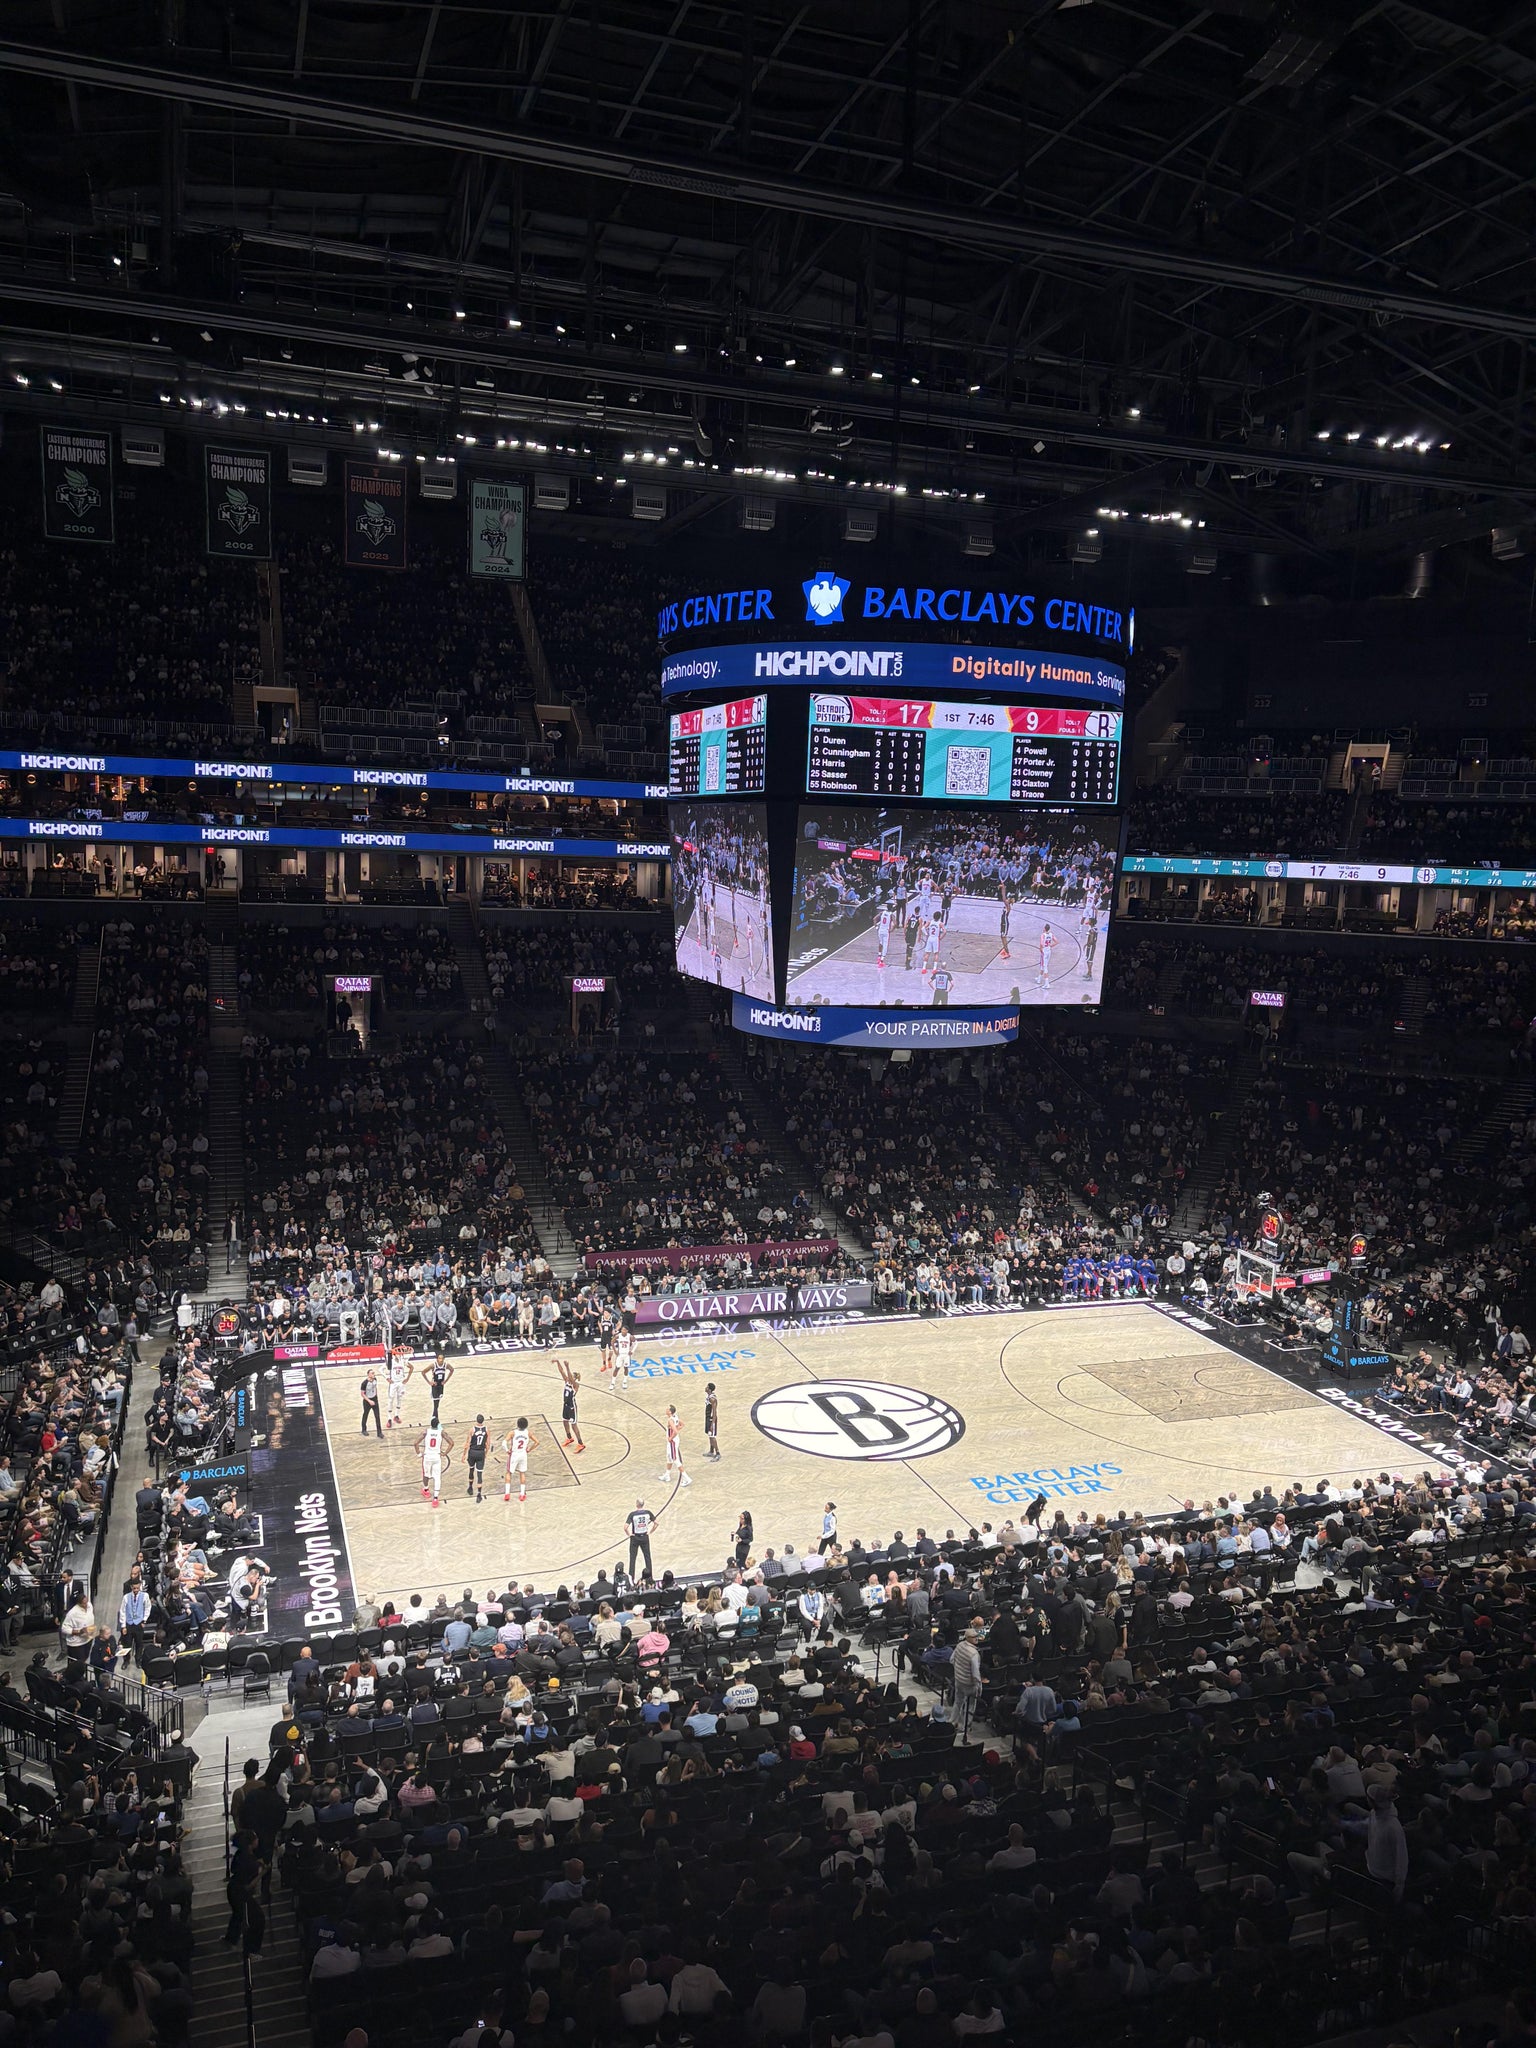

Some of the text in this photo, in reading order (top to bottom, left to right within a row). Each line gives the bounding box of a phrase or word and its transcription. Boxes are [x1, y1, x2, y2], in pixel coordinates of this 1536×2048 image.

[48, 445, 107, 466] CHAMPIONS
[210, 464, 266, 484] CHAMPIONS
[350, 478, 402, 497] CHAMPIONS
[488, 486, 509, 499] WNBA
[475, 496, 522, 513] CHAMPIONS
[64, 524, 96, 535] 2000
[224, 540, 255, 551] 2002
[361, 551, 390, 561] 2023
[485, 565, 510, 574] 2024
[682, 589, 775, 629] CENTER
[862, 587, 1122, 643] BARCLAYS CENTER
[667, 660, 721, 681] Technology.
[755, 651, 894, 677] HIGHPOINT
[952, 656, 1036, 683] Digitally
[1041, 663, 1095, 685] Human.
[730, 706, 737, 725] 9
[817, 705, 845, 714] DETROIT
[899, 704, 925, 725] 17
[816, 714, 845, 723] PISTONS
[945, 713, 995, 726] 1ST 7:46
[1026, 712, 1039, 732] 9
[814, 735, 820, 743] 0
[823, 736, 847, 746] Duren
[876, 739, 882, 747] 5
[890, 740, 895, 748] 1
[813, 747, 819, 755] 2
[822, 747, 871, 759] Cunningham
[890, 751, 894, 759] 1
[1023, 747, 1048, 756] Powell
[1073, 749, 1079, 757] 0
[1085, 749, 1091, 757] 0
[1110, 750, 1115, 758] 0
[21, 755, 101, 771] HIGHPOINT
[811, 759, 821, 767] 12
[821, 759, 846, 768] Harris
[875, 762, 881, 770] 2
[888, 762, 894, 770] 0
[903, 763, 908, 771] 1
[1023, 758, 1046, 767] Porter
[1046, 759, 1056, 767] Jr.
[1084, 760, 1090, 768] 0
[1109, 761, 1115, 769] 0
[194, 763, 267, 778] HIGHPOINT
[810, 770, 820, 778] 25
[821, 771, 848, 779] Sasser
[888, 773, 893, 781] 0
[902, 774, 907, 782] 1
[1022, 769, 1054, 779] Clowney
[1071, 770, 1077, 778] 0
[1085, 771, 1089, 779] 1
[353, 771, 423, 785] HIGHPOINT
[1012, 779, 1022, 787] 33
[1022, 780, 1050, 788] Claxton
[1071, 781, 1077, 789] 0
[505, 779, 571, 793] HIGHPOINT
[810, 781, 820, 789] 55
[821, 782, 858, 791] Robinson
[888, 784, 893, 792] 1
[901, 785, 907, 793] 2
[915, 785, 920, 793] 1
[1022, 790, 1045, 799] Traore
[1096, 792, 1100, 800] 1
[29, 823, 99, 836] HIGHPOINT
[202, 828, 266, 842] HIGHPOINT
[341, 834, 403, 846] HIGHPOINT
[494, 840, 550, 852] HIGHPOINT
[617, 844, 670, 856] HIGHPOINT
[1310, 866, 1327, 877] 17
[1338, 870, 1359, 879] 7:46
[1378, 868, 1386, 880] 9
[336, 978, 370, 987] QATAR
[574, 978, 604, 987] QATAR
[1252, 992, 1283, 1002] QATAR
[750, 1009, 815, 1032] HIGHPOINT
[866, 1016, 1018, 1037] YOUR PARTNER IN A DIGITAL
[657, 1295, 740, 1321] QATAR
[218, 1322, 234, 1332] 24
[1358, 1355, 1389, 1365] BARCLAYS
[628, 1360, 739, 1379] CENTER
[807, 1391, 910, 1449] B
[1317, 1388, 1425, 1442] Brooklyn
[430, 1438, 437, 1448] 0
[518, 1440, 524, 1450] 2
[193, 1465, 246, 1480] BARCLAYS
[969, 1461, 1123, 1491] BARCLAYS
[986, 1479, 1113, 1506] CENTER
[294, 1492, 343, 1628] Brooklyn Nets
